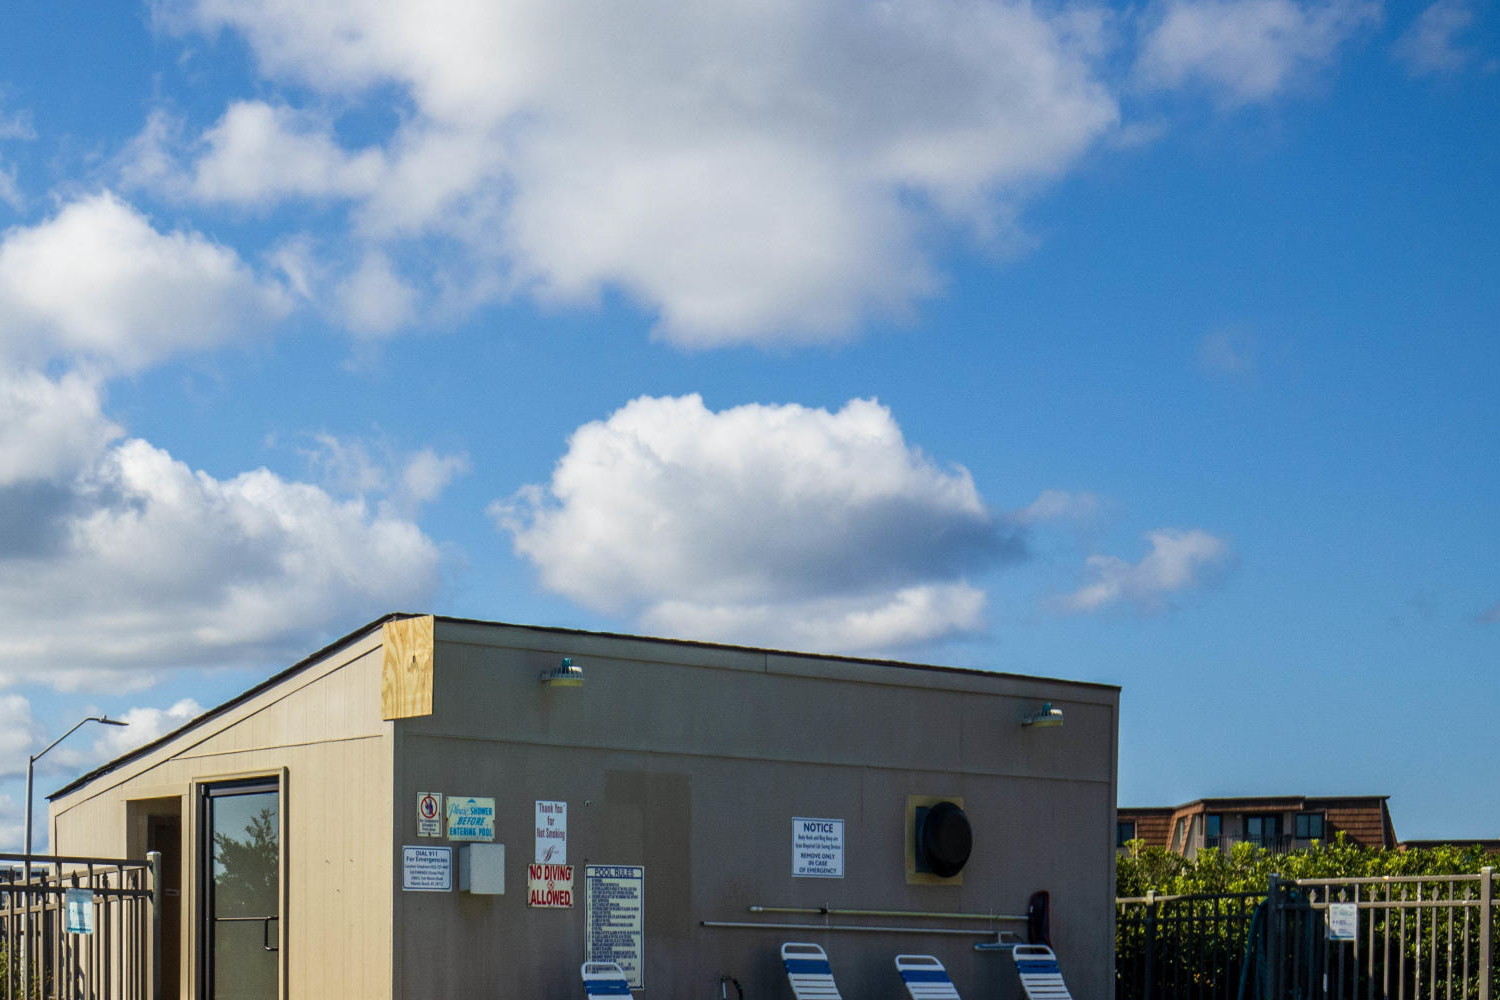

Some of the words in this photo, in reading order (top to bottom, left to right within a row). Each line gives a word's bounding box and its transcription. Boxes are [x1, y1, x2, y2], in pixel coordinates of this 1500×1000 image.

[470, 807, 493, 816] SHOWER
[457, 816, 485, 826] BEFORE
[449, 826, 477, 836] ENTERING
[478, 828, 493, 837] POOL
[803, 822, 833, 833] NOTICE
[546, 828, 565, 841] Smoking
[530, 864, 542, 880] NO
[544, 864, 572, 881] DIVING
[595, 867, 613, 877] POOL
[614, 868, 635, 878] RULES
[531, 888, 571, 906] ALLOWED
